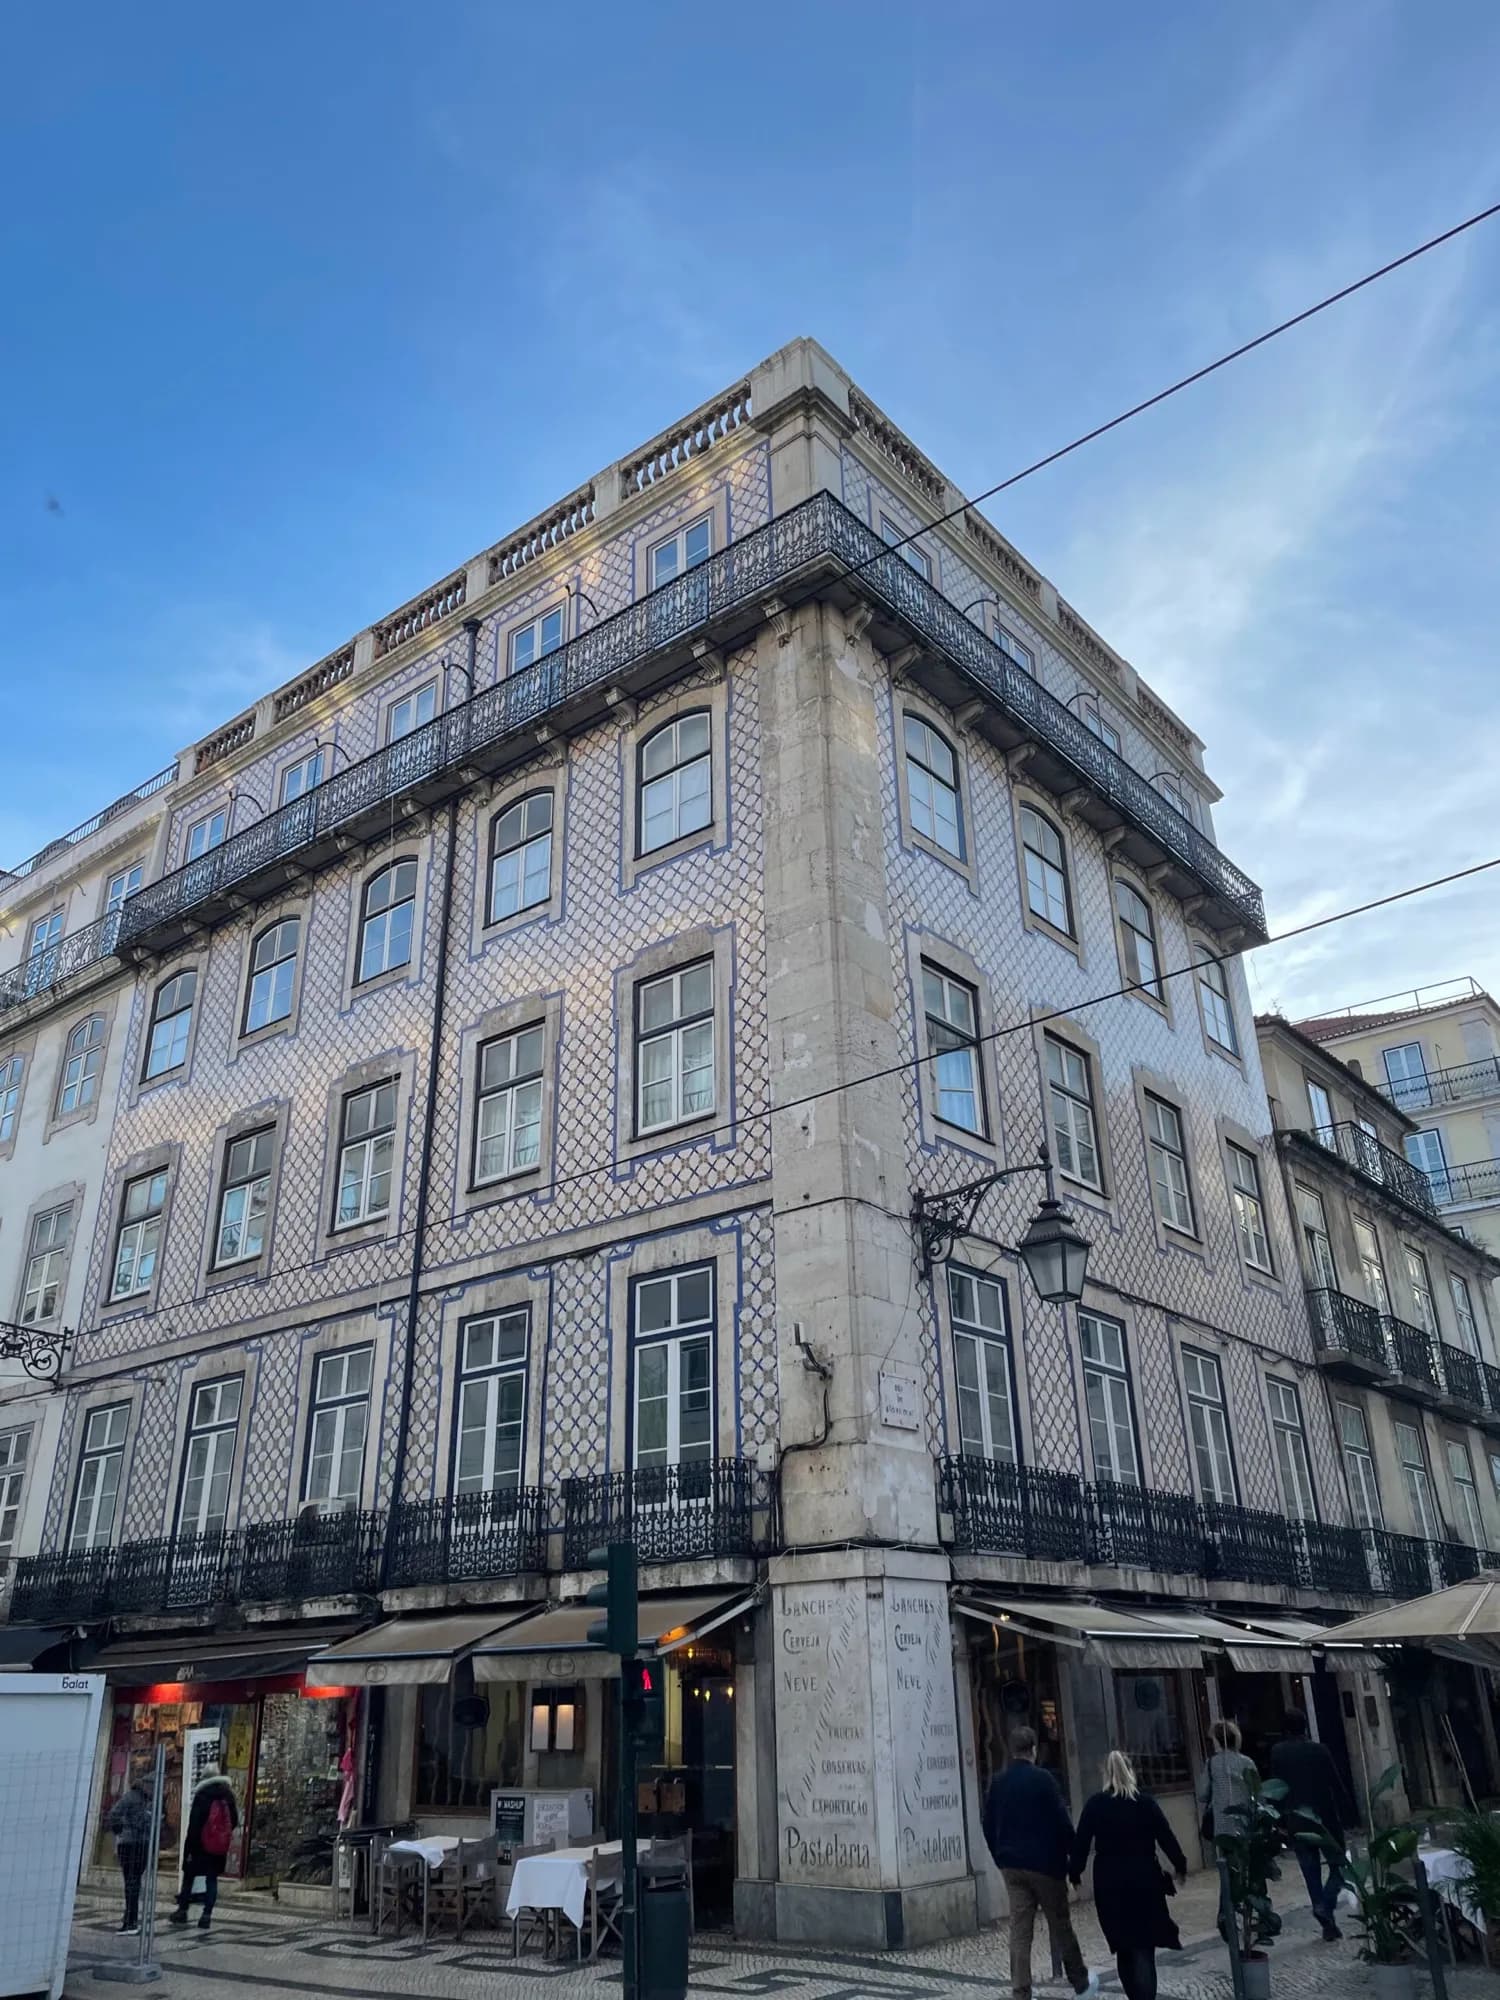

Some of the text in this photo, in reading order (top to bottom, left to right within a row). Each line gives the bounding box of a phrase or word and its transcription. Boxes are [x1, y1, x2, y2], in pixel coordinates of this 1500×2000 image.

[783, 1628, 820, 1654] CERVEJA
[784, 1671, 817, 1692] NEVE
[897, 1667, 921, 1690] NEVE
[784, 1825, 871, 1869] Pastelaria
